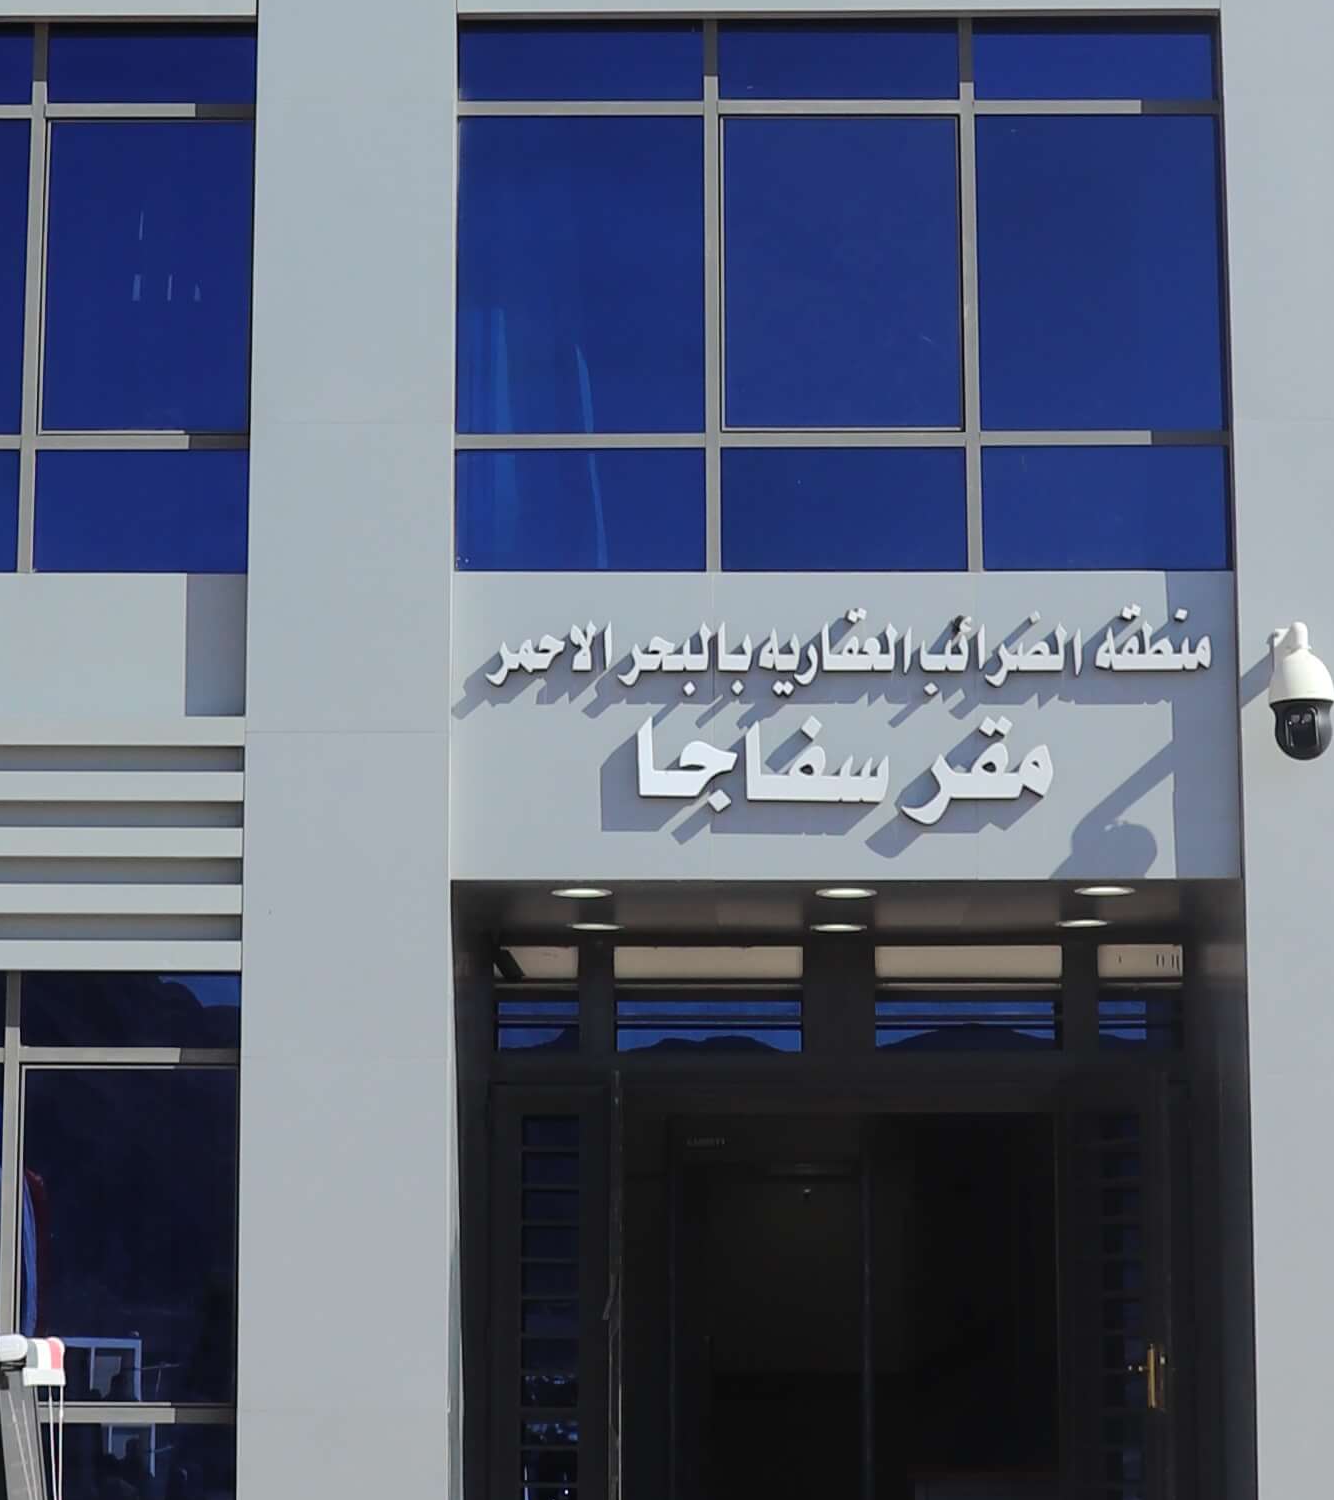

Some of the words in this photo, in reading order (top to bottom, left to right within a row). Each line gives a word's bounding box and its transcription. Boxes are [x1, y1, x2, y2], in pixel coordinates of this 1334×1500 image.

[485, 620, 612, 687] الاحمر
[617, 621, 753, 696] بالبحر
[920, 610, 1083, 696] الضرائب
[637, 715, 890, 813] سفاجا
[900, 715, 1055, 825] مقر
